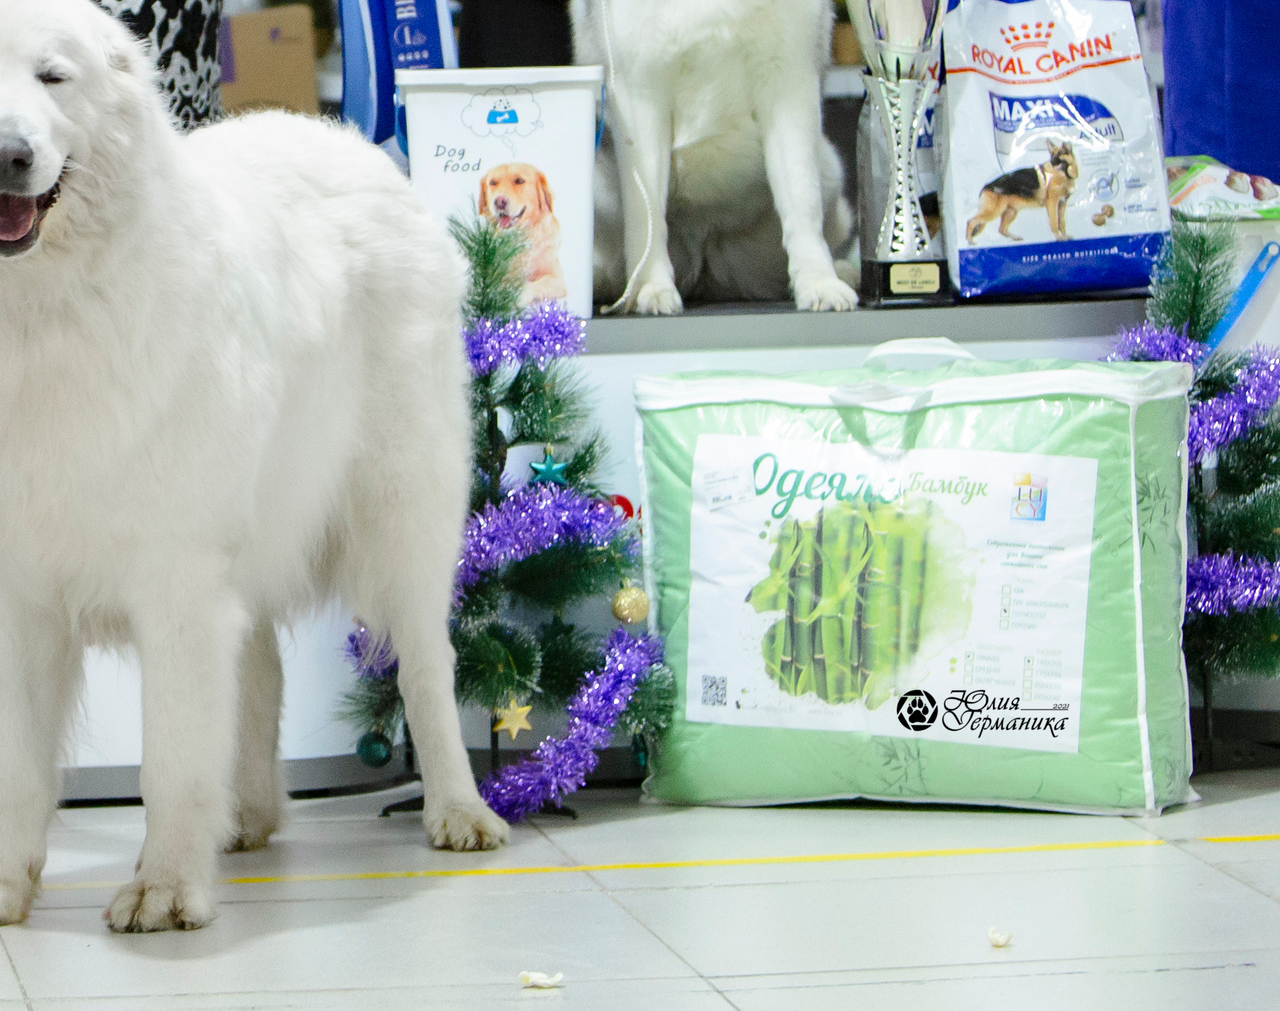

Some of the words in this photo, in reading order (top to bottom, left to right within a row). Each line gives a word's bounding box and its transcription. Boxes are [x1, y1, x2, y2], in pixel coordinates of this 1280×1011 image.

[971, 44, 1031, 75] ROYAL
[1036, 33, 1112, 73] CANIN
[992, 97, 1054, 121] MAXI
[1079, 123, 1116, 140] Ault
[434, 144, 465, 160] Dog
[444, 158, 482, 173] food
[908, 471, 989, 506] Бамбук
